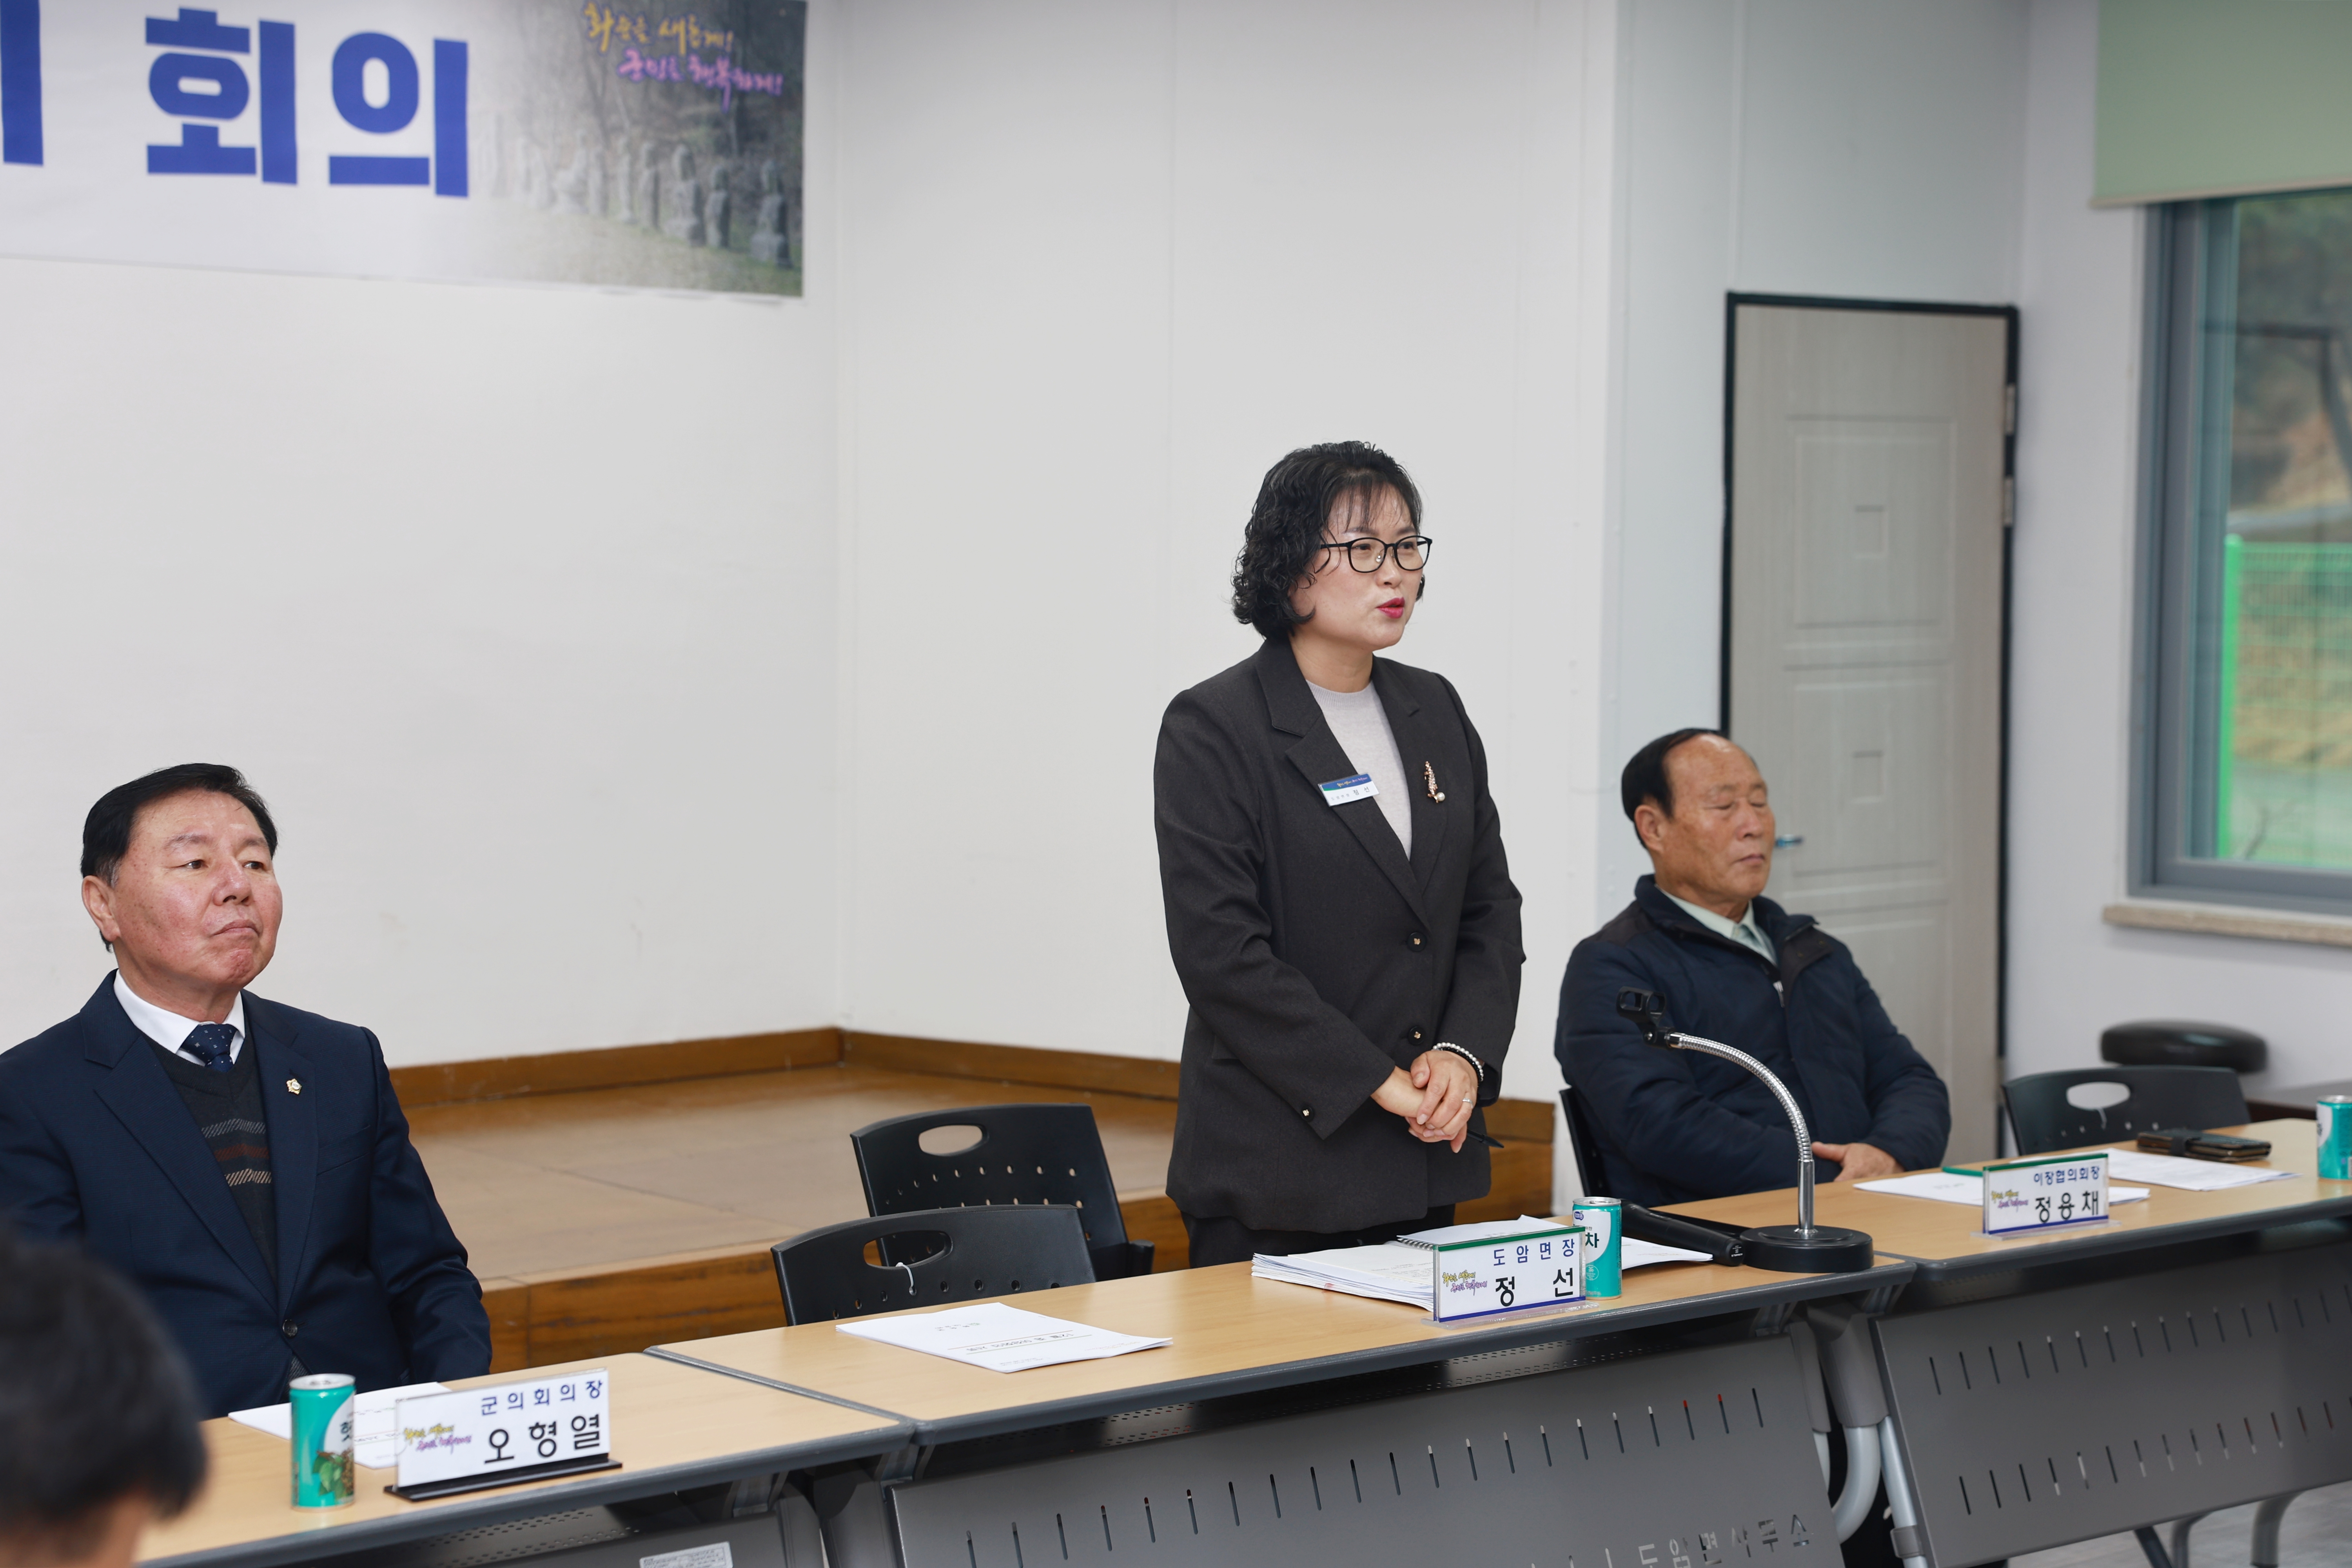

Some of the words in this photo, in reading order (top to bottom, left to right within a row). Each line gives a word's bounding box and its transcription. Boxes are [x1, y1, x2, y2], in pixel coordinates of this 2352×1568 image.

[146, 8, 468, 198] 회의
[2034, 1166, 2100, 1186] 이장협의회장
[2035, 1190, 2099, 1223] 정용채
[1493, 1238, 1575, 1266] 도암면장
[481, 1379, 603, 1416] 군의회의장
[484, 1413, 601, 1465] 오형열
